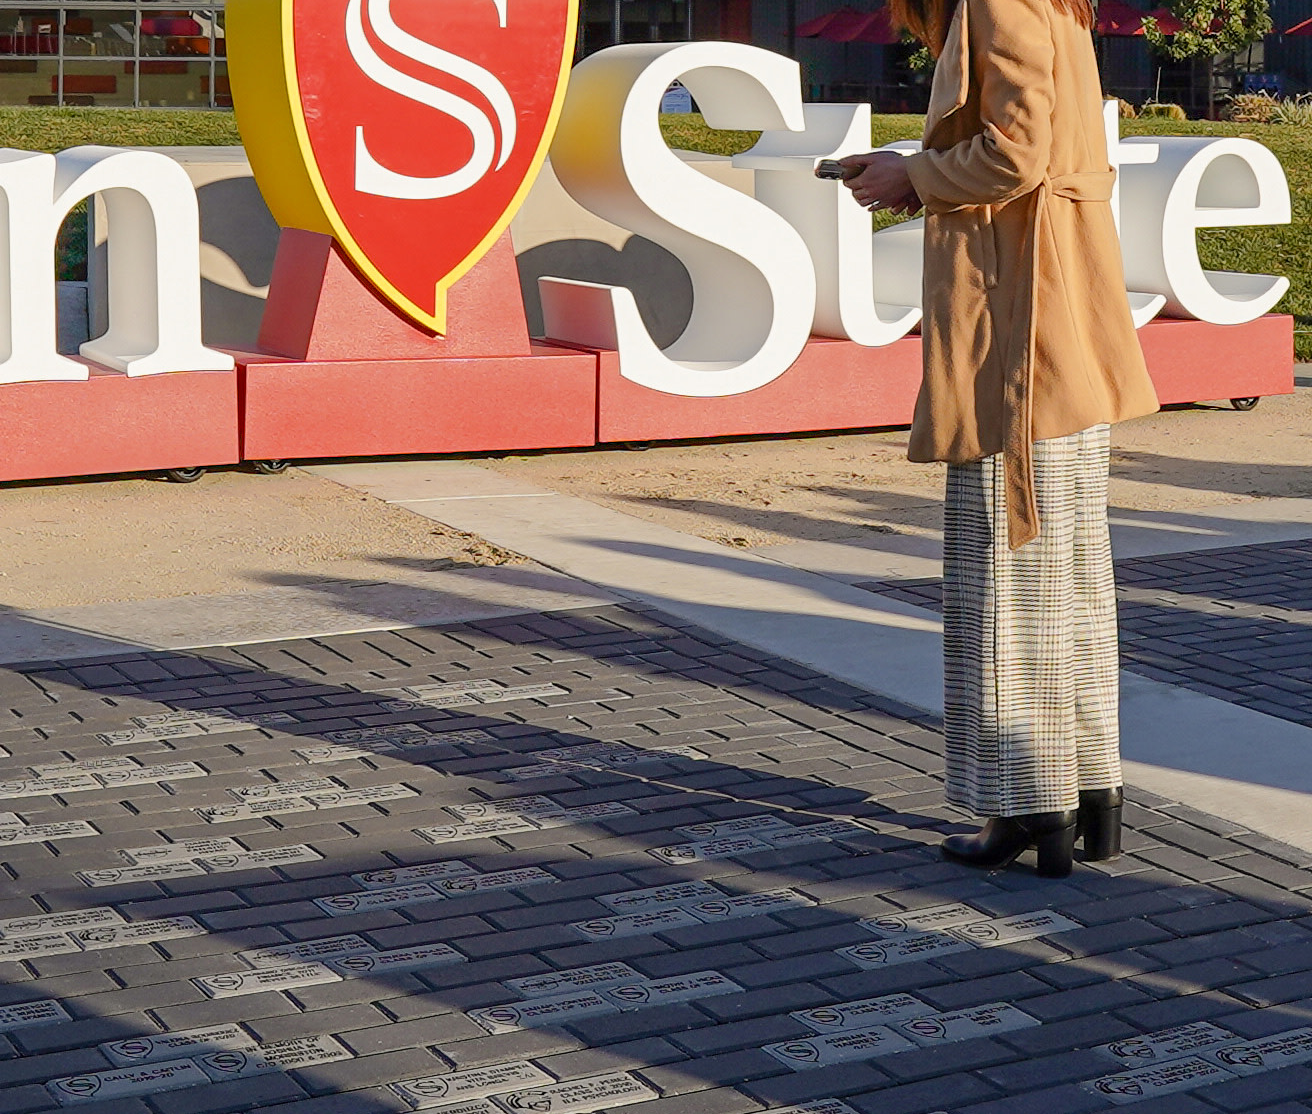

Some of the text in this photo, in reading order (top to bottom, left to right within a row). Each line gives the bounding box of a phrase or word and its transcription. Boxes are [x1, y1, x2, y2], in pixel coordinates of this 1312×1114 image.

[166, 1039, 198, 1048] CLASS
[261, 1046, 303, 1055] JOSHUA
[546, 1084, 588, 1093] RACHEL
[557, 1089, 594, 1097] CLASS
[579, 1086, 646, 1100] PSYCHOLOGY
